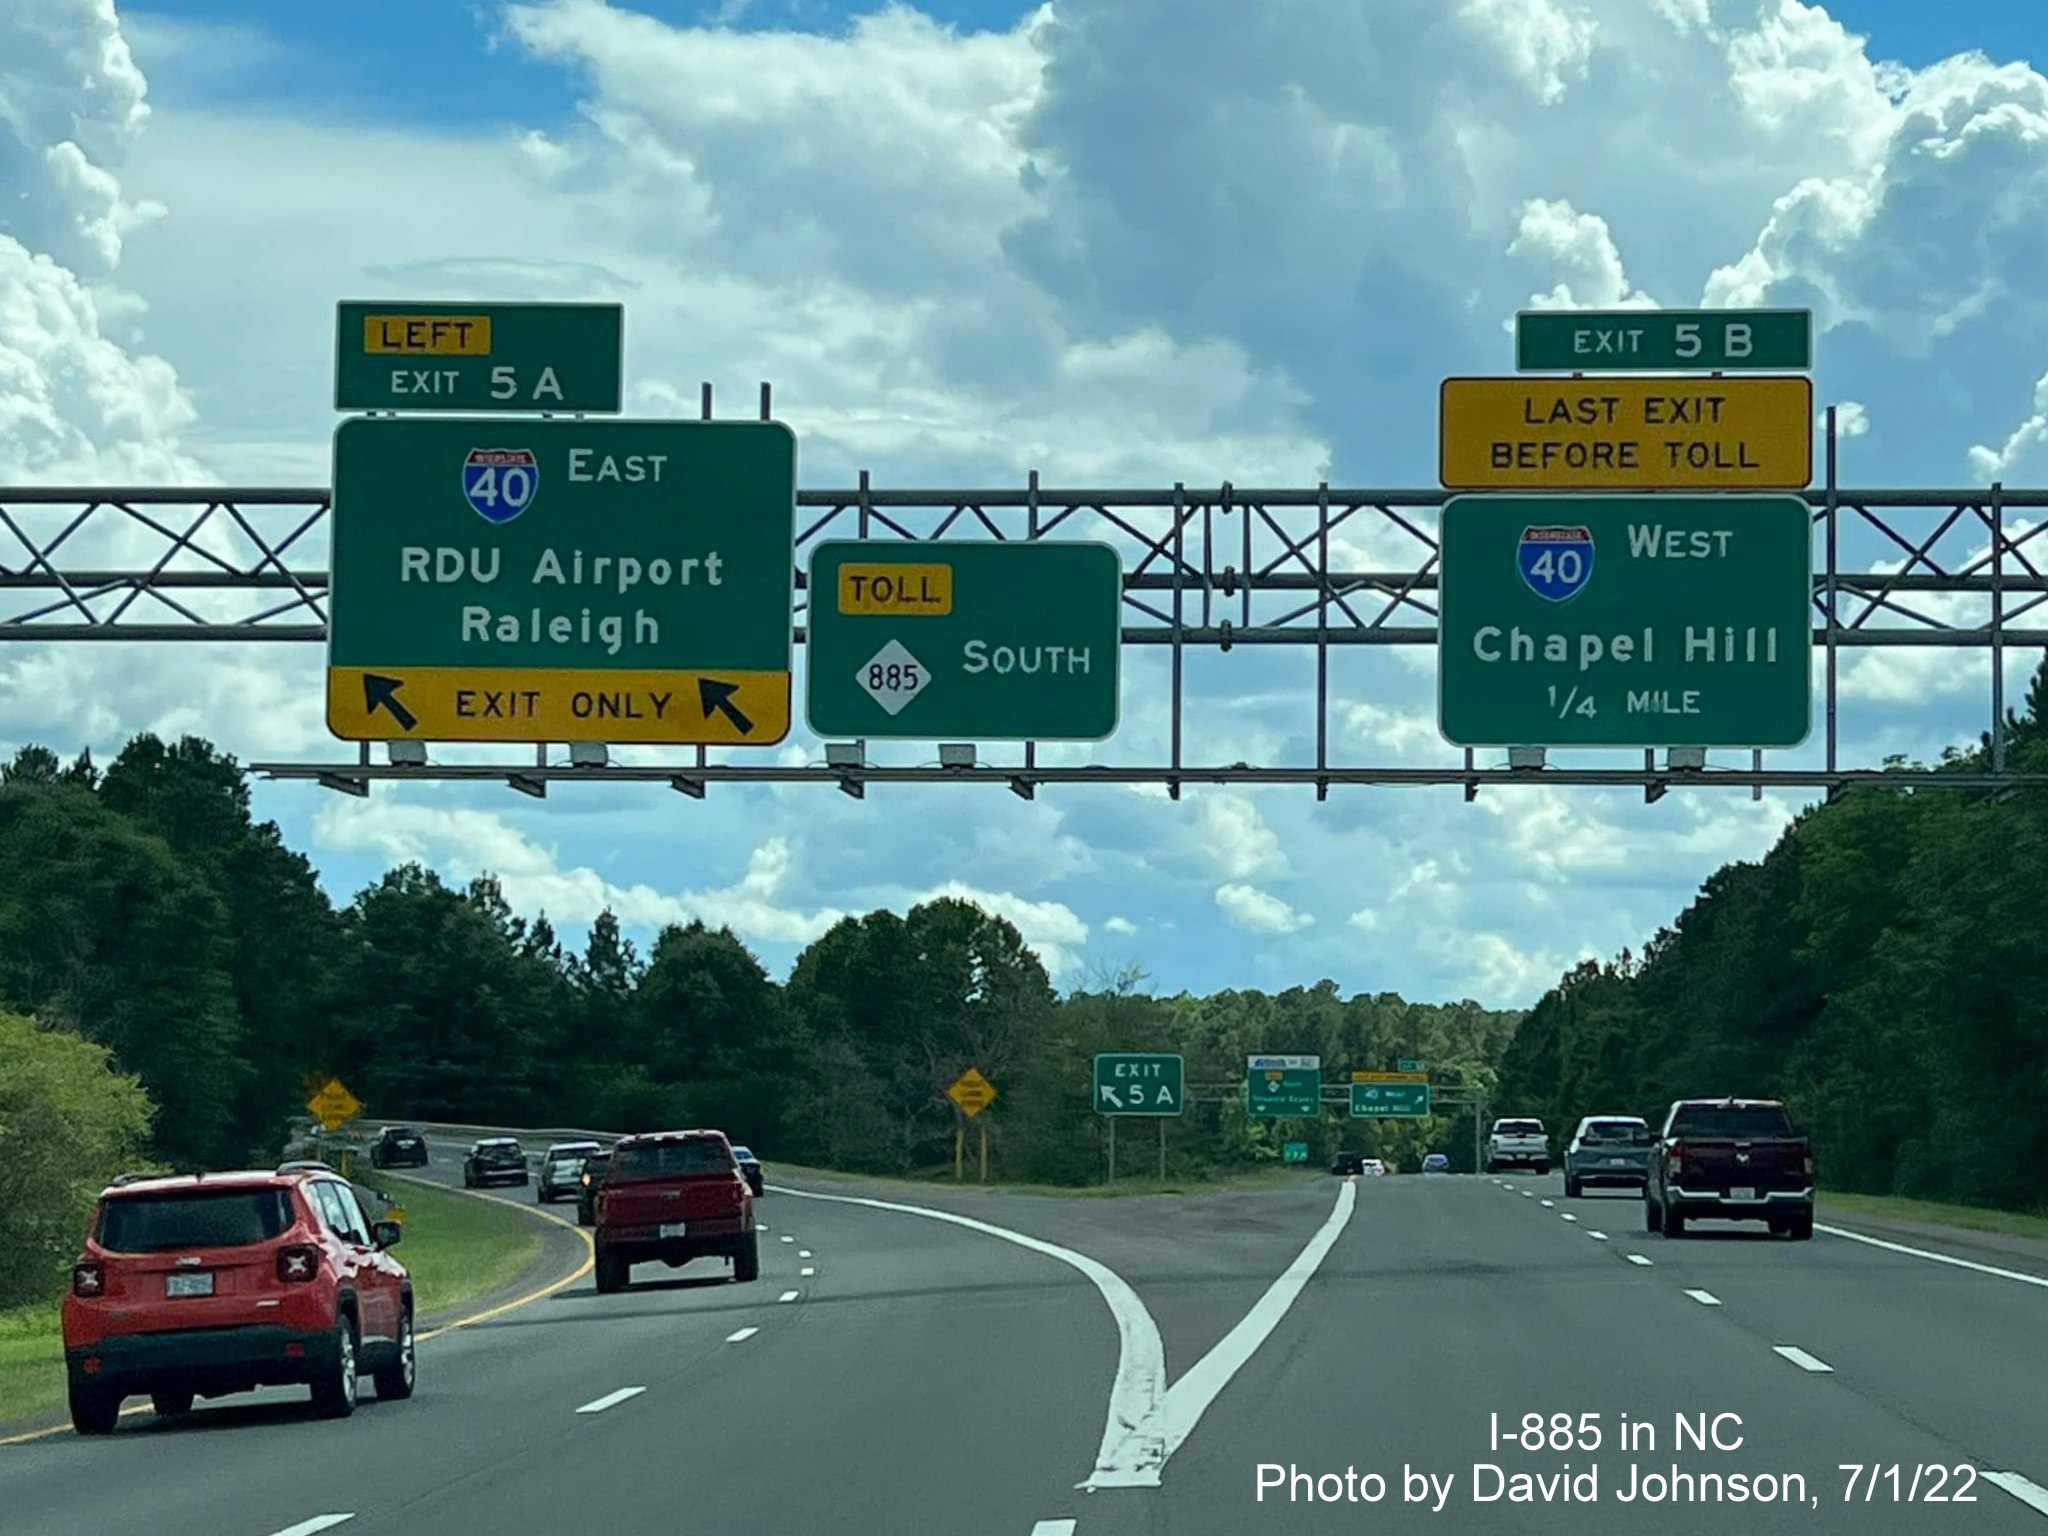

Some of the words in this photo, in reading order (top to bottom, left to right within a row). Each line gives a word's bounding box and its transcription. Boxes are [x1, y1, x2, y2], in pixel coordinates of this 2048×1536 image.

[382, 322, 473, 348] LEFT
[1574, 330, 1643, 353] EXIT
[1676, 324, 1701, 357] 5
[1726, 324, 1752, 357] B
[392, 371, 459, 393] EXIT
[491, 367, 517, 399] 5
[533, 367, 563, 400] A
[1525, 398, 1619, 424] LAST
[1645, 397, 1725, 423] EXIT
[1492, 442, 1638, 469] BEFORE
[1665, 442, 1759, 468] TOLL
[469, 468, 530, 507] 40
[569, 448, 667, 481] EAST
[1530, 550, 1582, 584] 40
[1628, 525, 1733, 557] WEST
[402, 547, 499, 582] RDU
[532, 549, 722, 593] Airport
[849, 576, 940, 602] TOLL
[462, 606, 658, 655] Raleigh
[1474, 627, 1652, 670] Chapel
[1686, 627, 1776, 662] Hill
[869, 665, 918, 691] 885
[963, 640, 1089, 673] SOUTH
[457, 691, 540, 717] EXIT
[572, 692, 672, 718] ONLY
[1628, 691, 1700, 713] MILE
[1115, 1064, 1160, 1077] EXIT
[1130, 1085, 1144, 1104] 5
[1157, 1086, 1173, 1104] A
